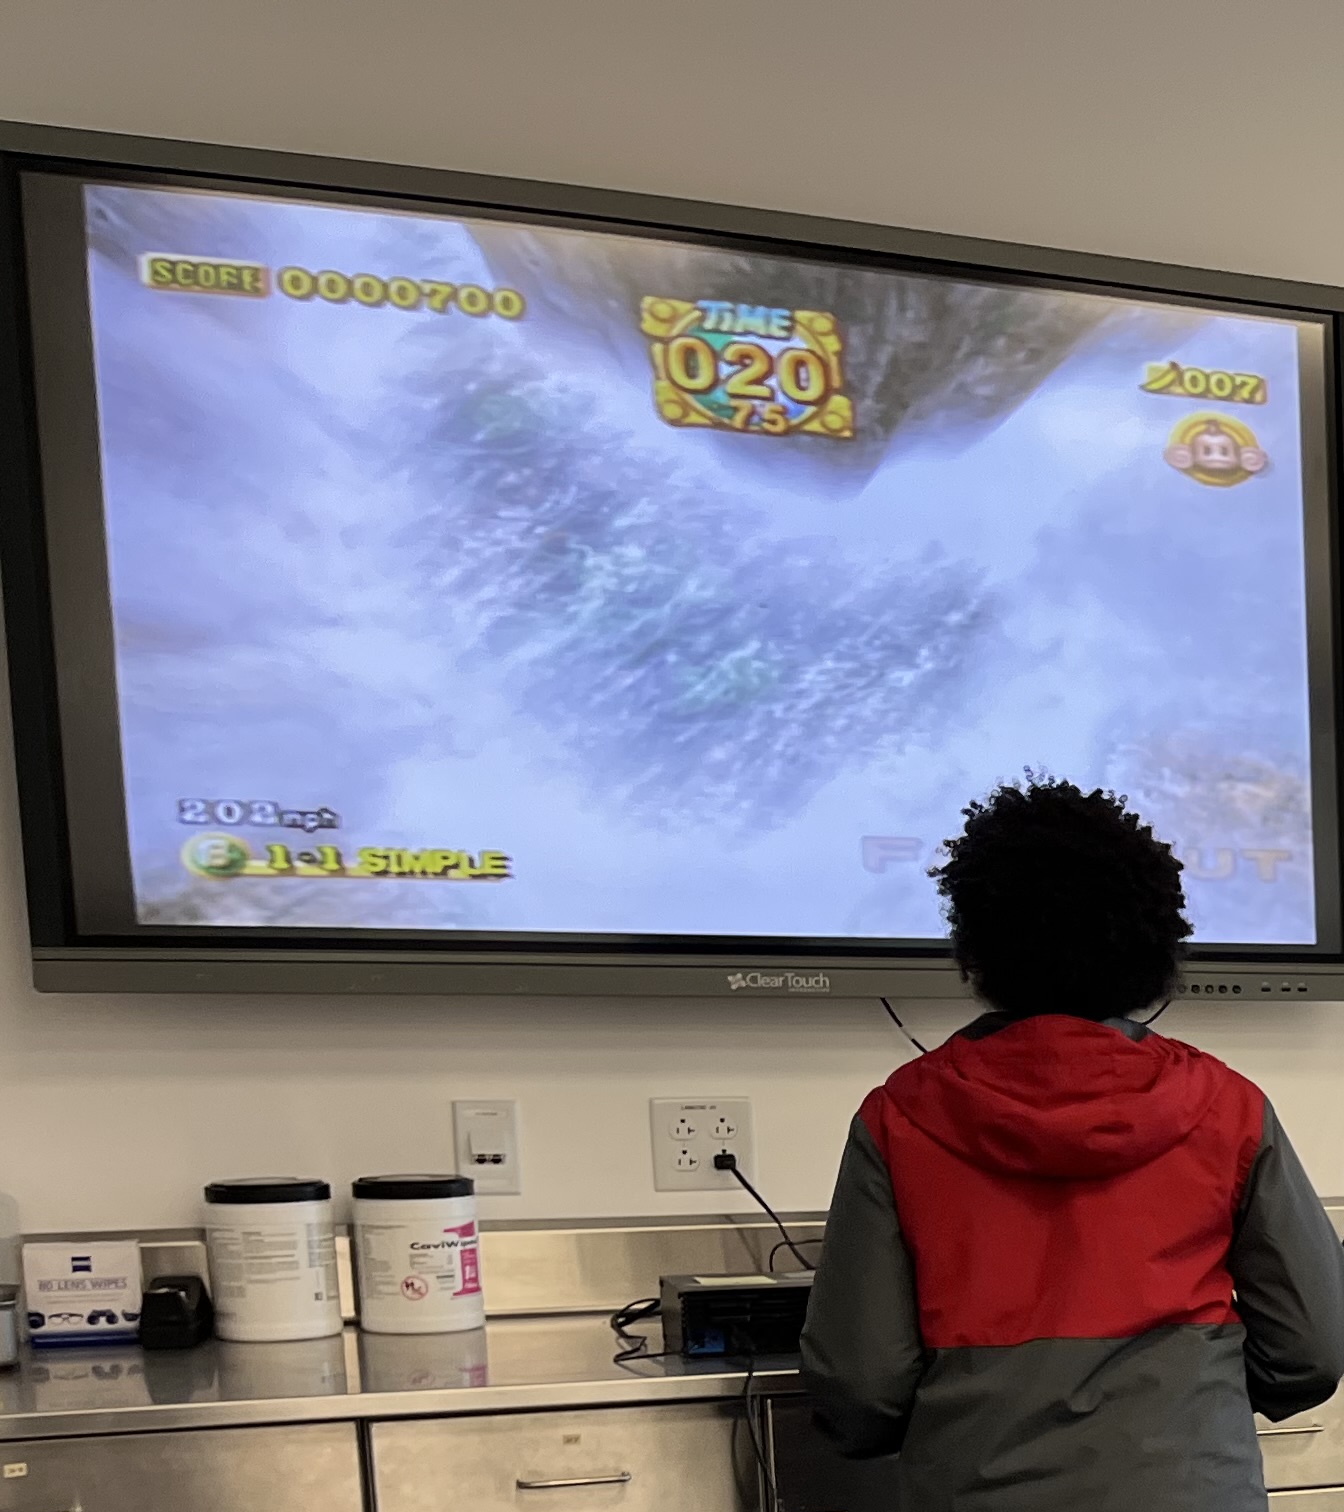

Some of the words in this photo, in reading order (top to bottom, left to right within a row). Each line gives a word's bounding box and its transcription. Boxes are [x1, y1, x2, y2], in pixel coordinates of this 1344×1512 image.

[278, 264, 526, 321] 0000700
[696, 299, 794, 340] TIME
[667, 336, 826, 404] 020
[1182, 368, 1260, 402] 007
[356, 846, 515, 879] SIMPLE
[57, 1278, 88, 1292] LENS
[90, 1276, 128, 1291] WIPES
